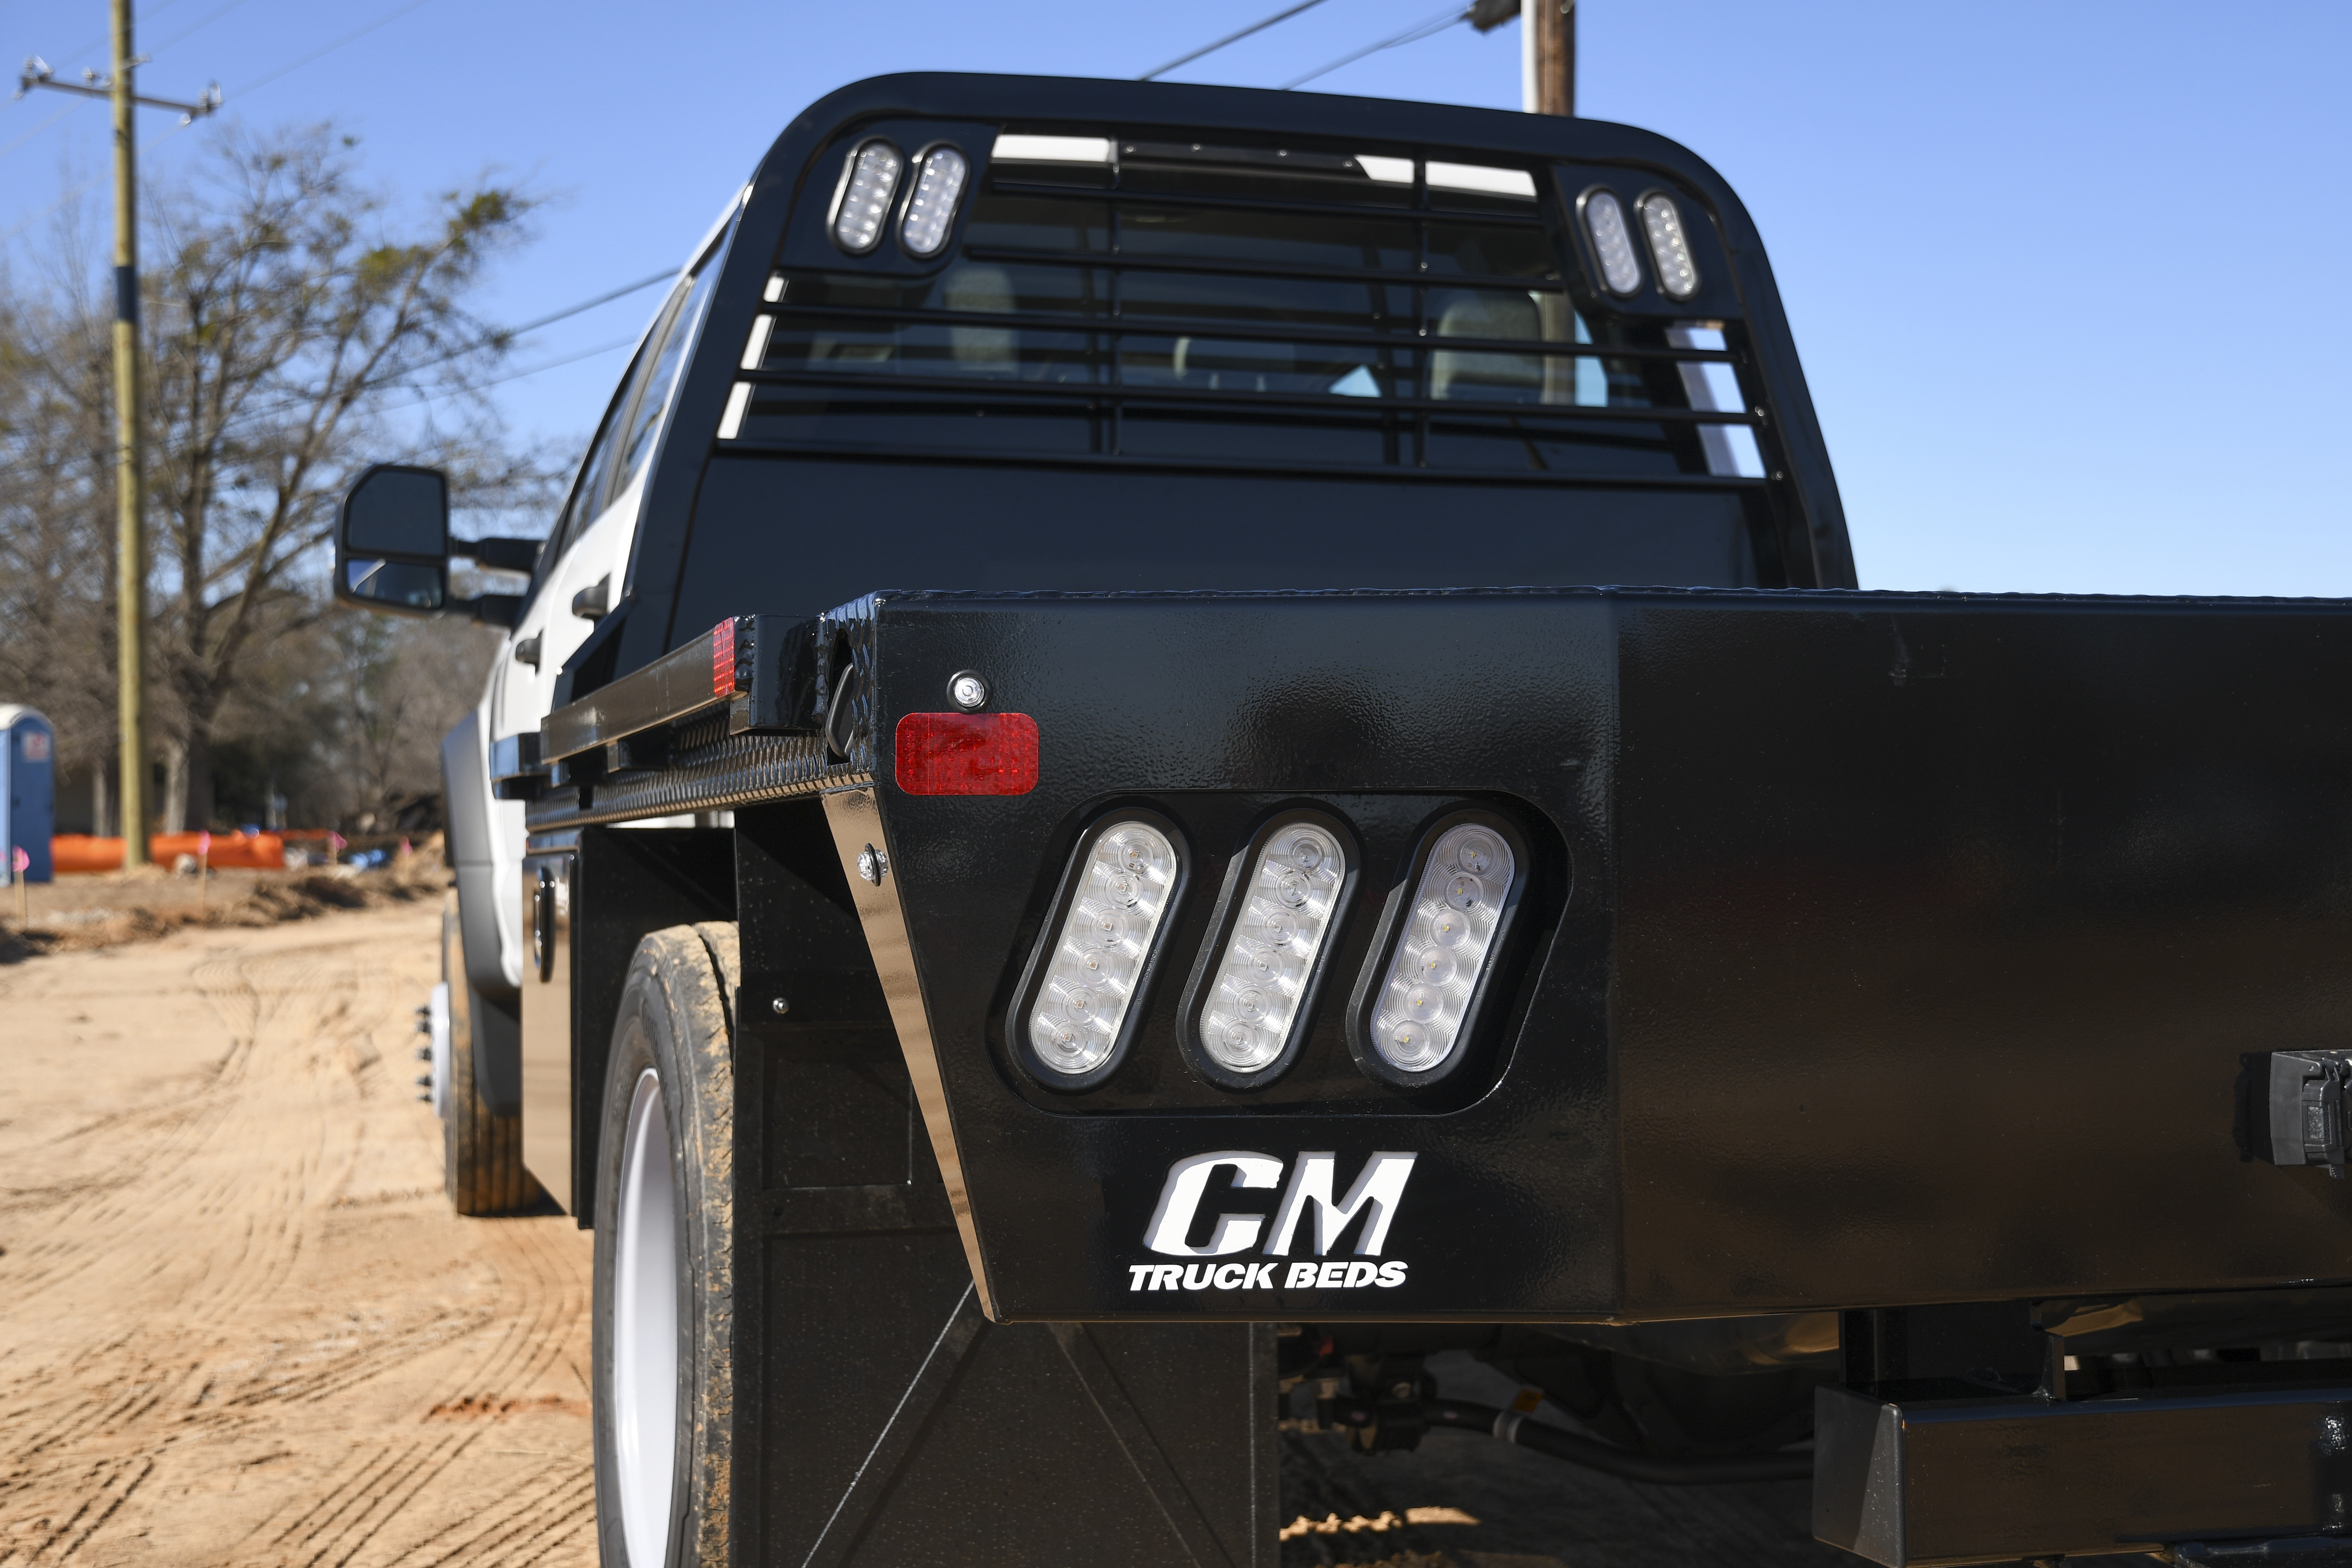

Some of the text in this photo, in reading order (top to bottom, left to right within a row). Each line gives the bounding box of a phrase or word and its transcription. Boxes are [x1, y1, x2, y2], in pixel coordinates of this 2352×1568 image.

[1143, 1150, 1418, 1257] CM
[1129, 1261, 1408, 1291] TRUCK BEDS
